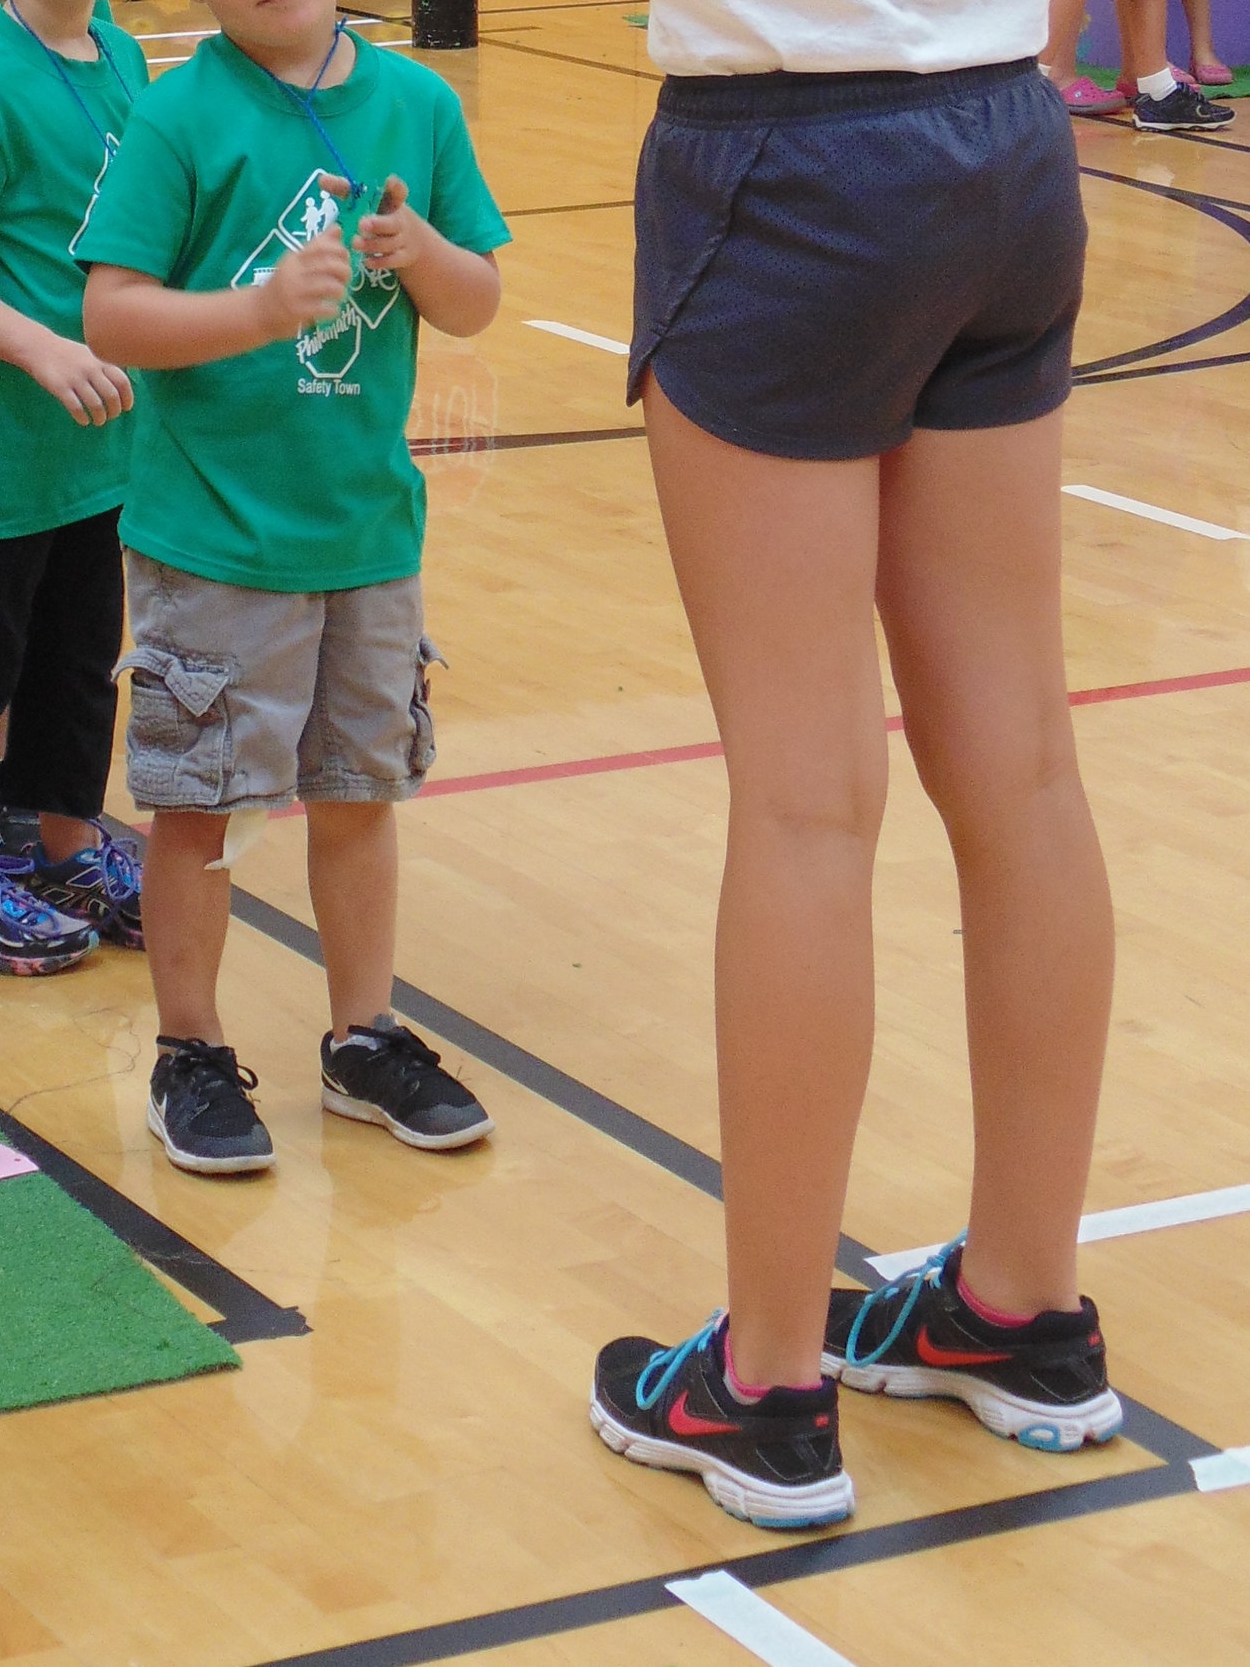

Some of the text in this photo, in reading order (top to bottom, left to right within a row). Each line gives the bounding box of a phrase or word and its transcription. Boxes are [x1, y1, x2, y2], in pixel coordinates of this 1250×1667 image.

[295, 303, 357, 364] Philomath
[297, 378, 361, 397] Safety Town
